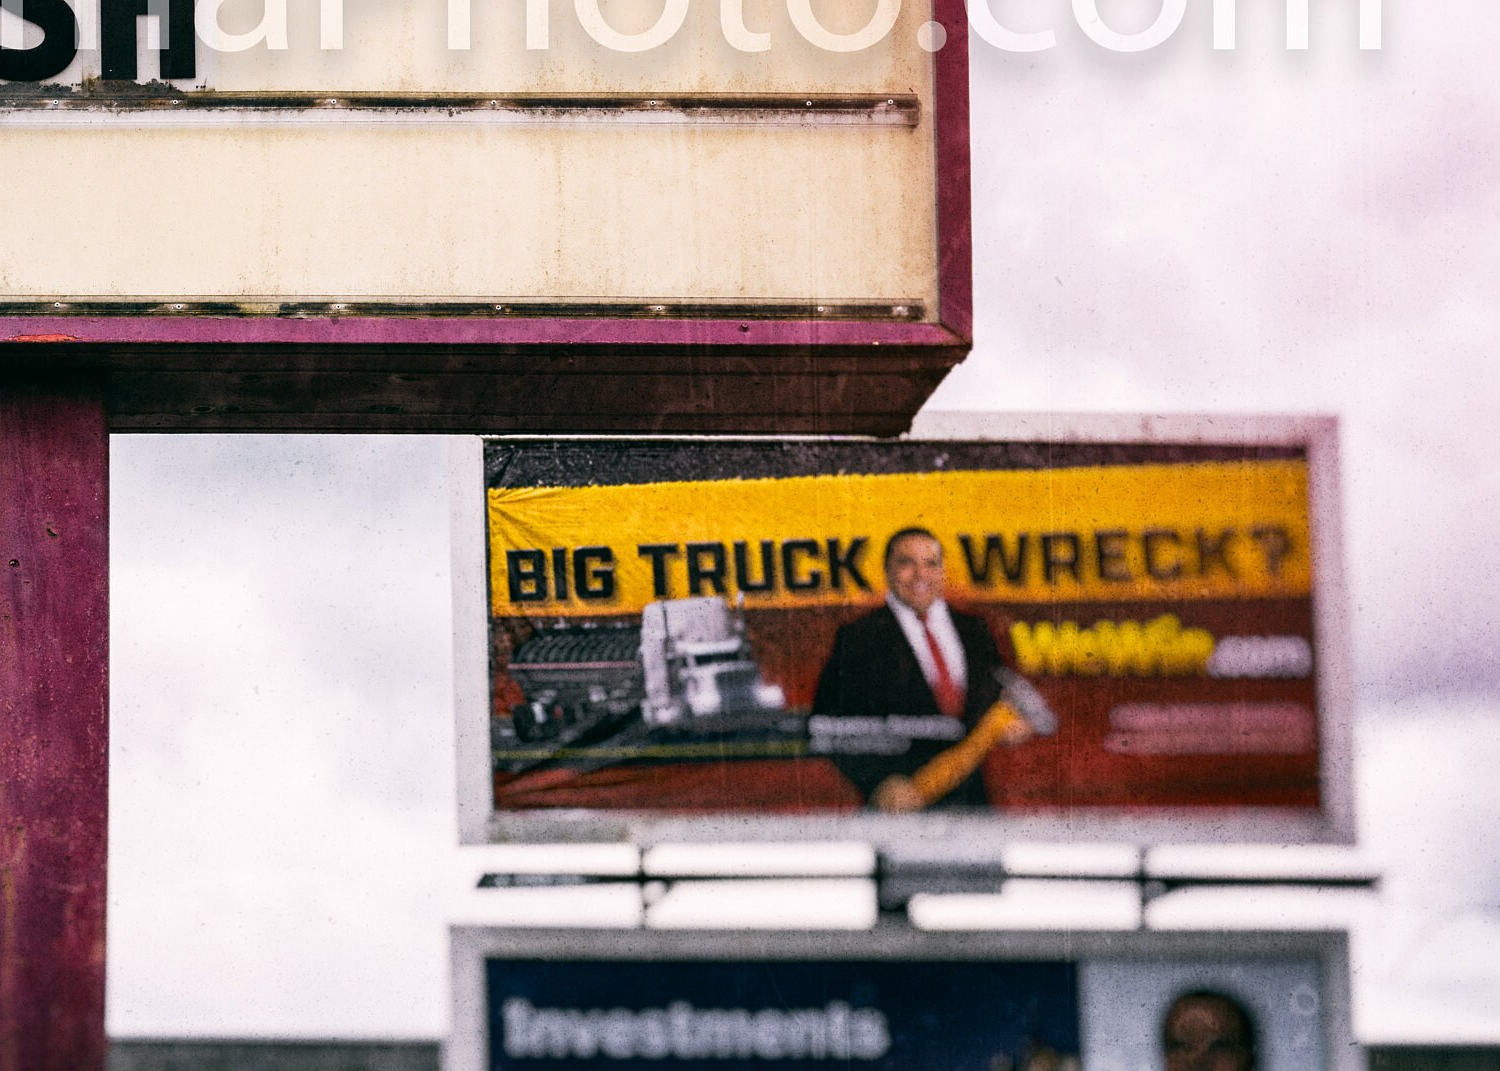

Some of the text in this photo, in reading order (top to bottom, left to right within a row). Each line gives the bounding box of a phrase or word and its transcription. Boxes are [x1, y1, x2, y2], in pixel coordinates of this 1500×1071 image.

[506, 528, 1296, 602] BIG TRUCK WRECK?
[503, 996, 890, 1060] Investments
